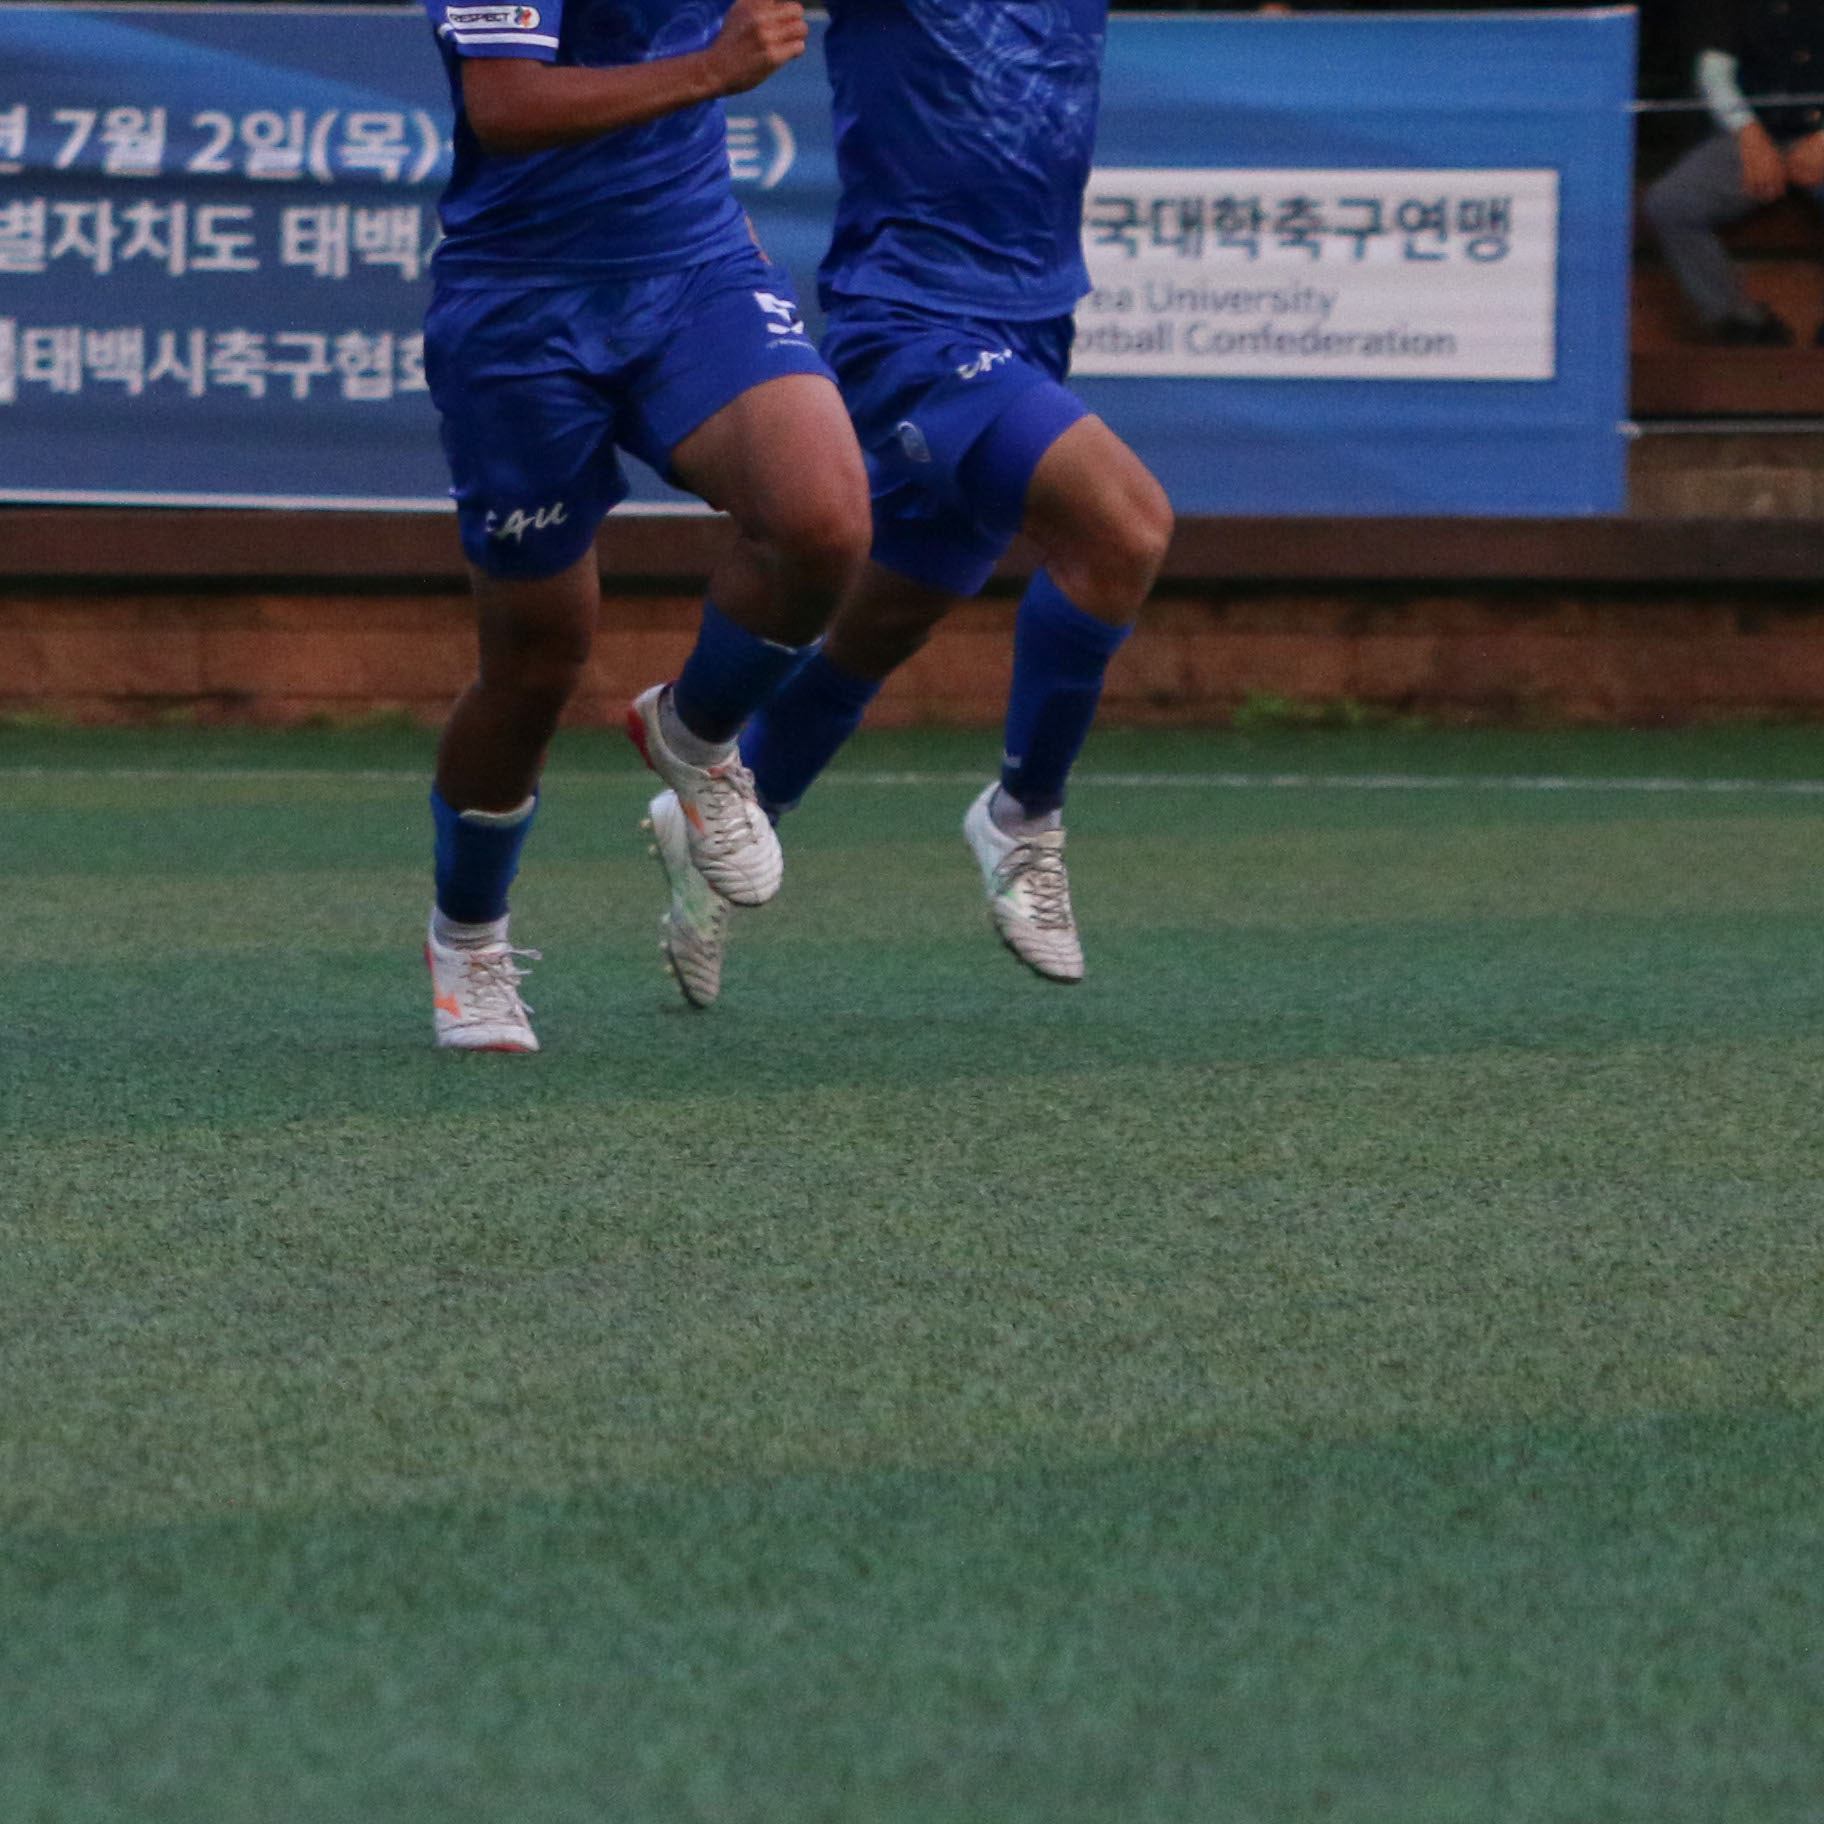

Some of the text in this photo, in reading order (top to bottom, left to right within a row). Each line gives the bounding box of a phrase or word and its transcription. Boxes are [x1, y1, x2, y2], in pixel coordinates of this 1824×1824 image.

[53, 107, 167, 176] 7월
[187, 108, 452, 184] 2일(목)
[281, 204, 446, 280] 태백
[1088, 194, 1512, 263] 국대학축구연맹
[1185, 321, 1459, 356] Confederation
